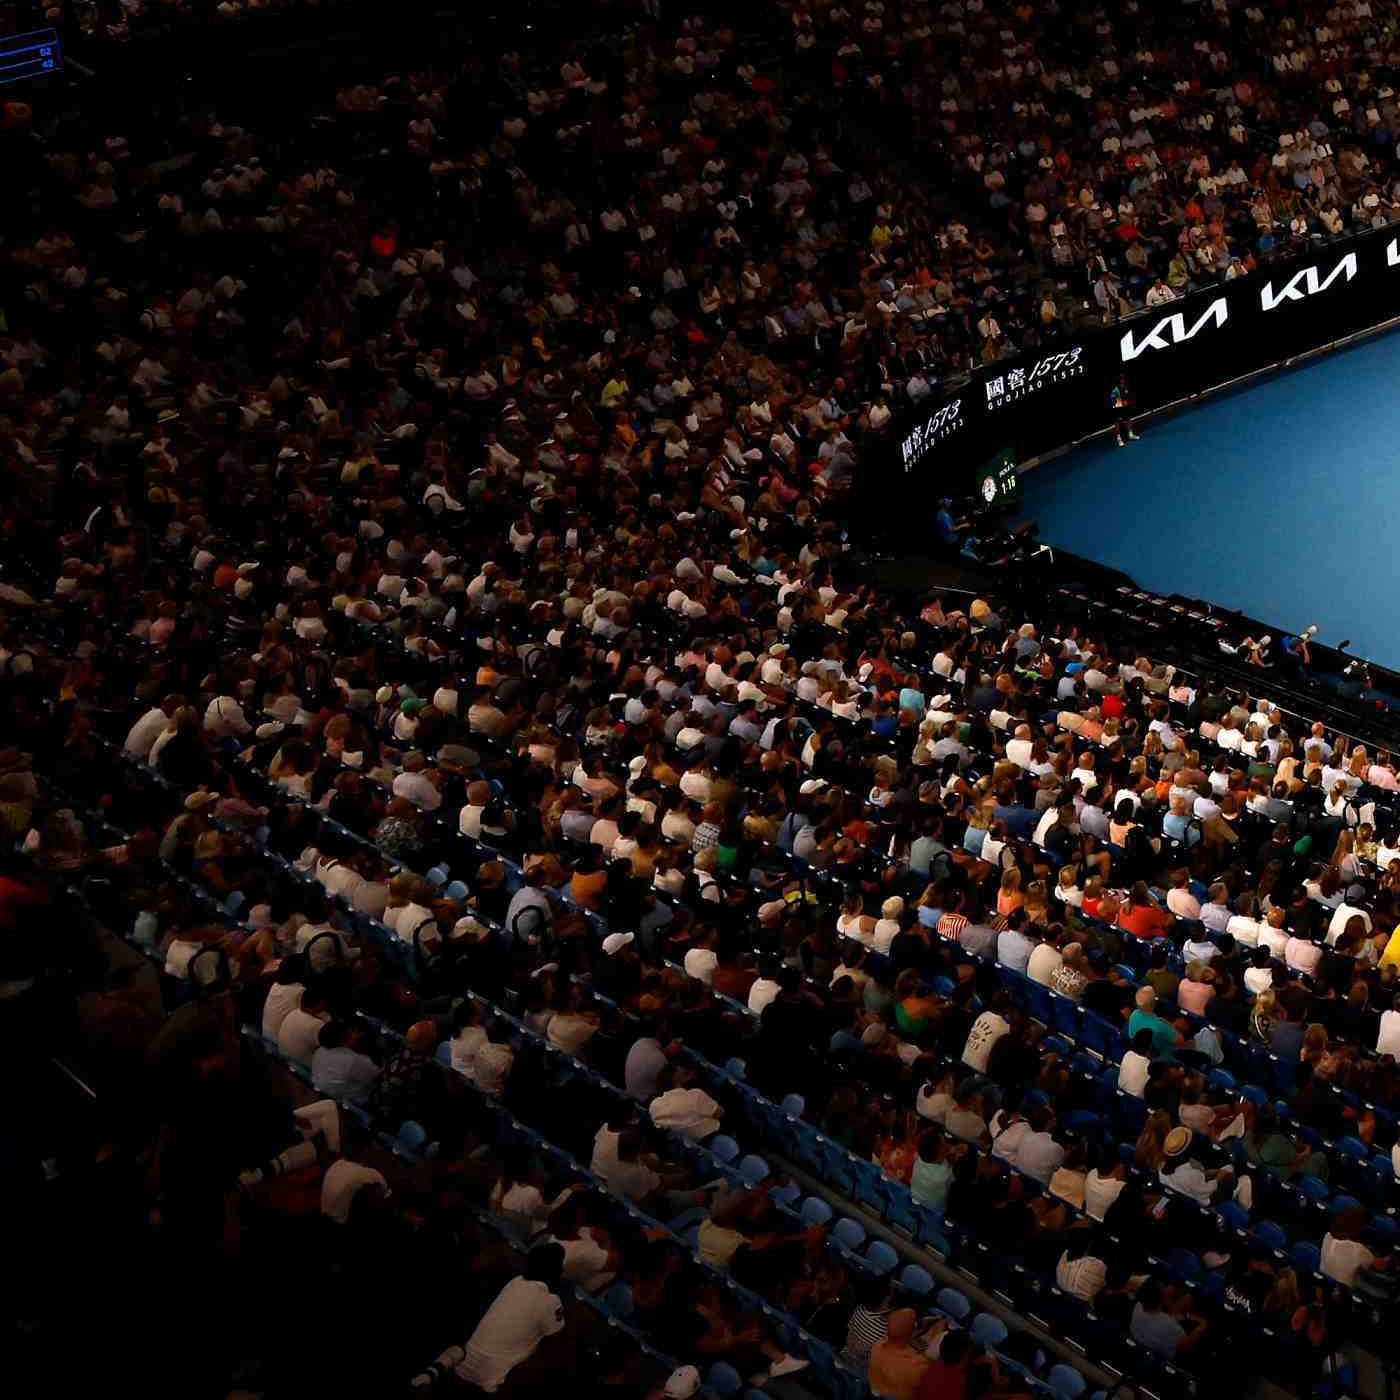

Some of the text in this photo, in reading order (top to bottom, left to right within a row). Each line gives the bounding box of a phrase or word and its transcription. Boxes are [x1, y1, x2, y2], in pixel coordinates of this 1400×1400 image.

[1260, 252, 1357, 311] KIA
[1120, 297, 1228, 362] KIA
[988, 365, 1084, 410] GUOJIAO 1573
